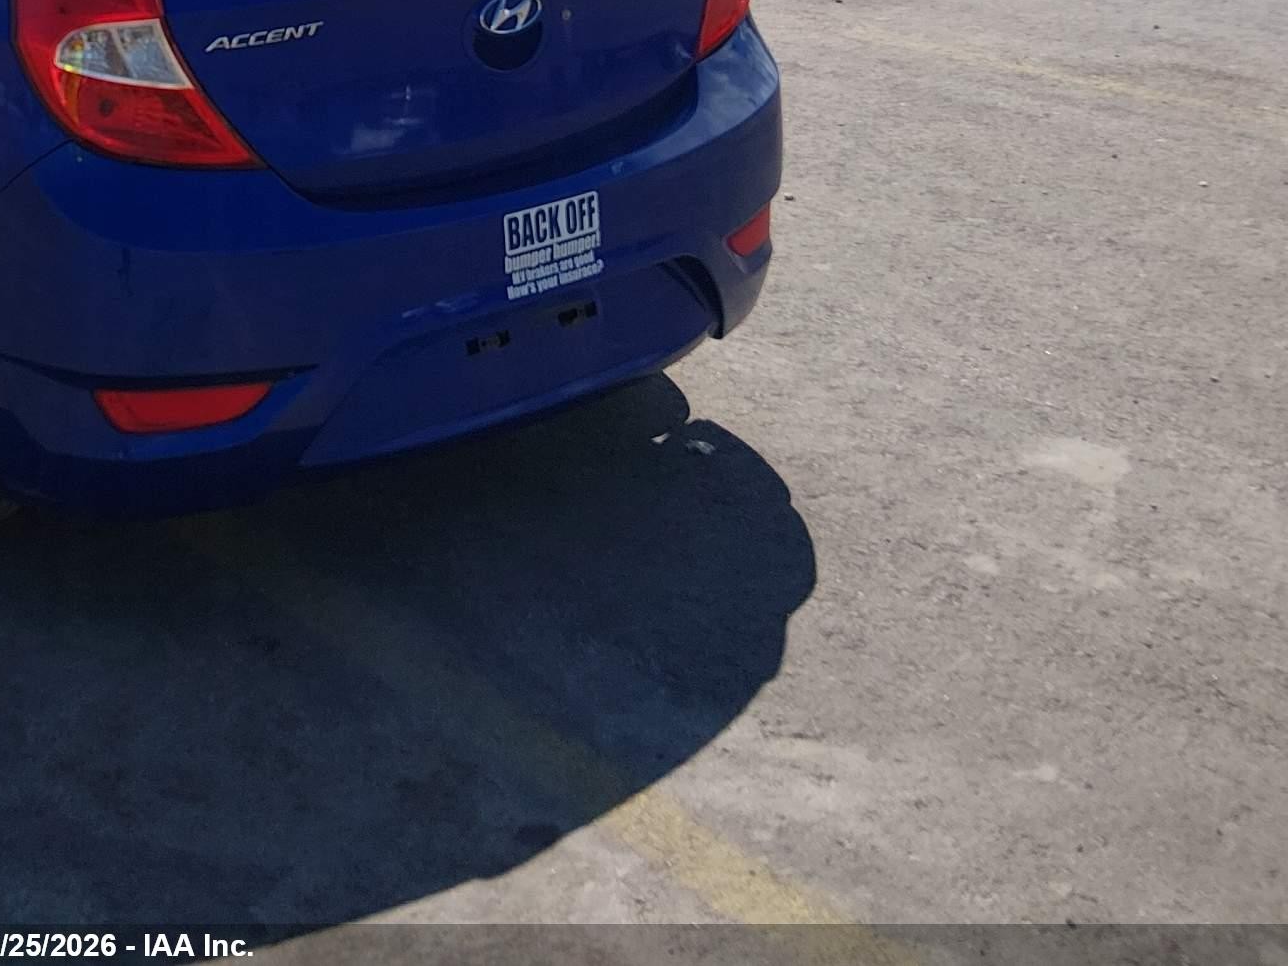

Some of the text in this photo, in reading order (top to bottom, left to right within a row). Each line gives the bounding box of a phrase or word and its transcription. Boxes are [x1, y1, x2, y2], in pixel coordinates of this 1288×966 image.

[206, 21, 323, 52] ACCENT
[507, 195, 596, 251] BACK OFF
[536, 275, 559, 294] your
